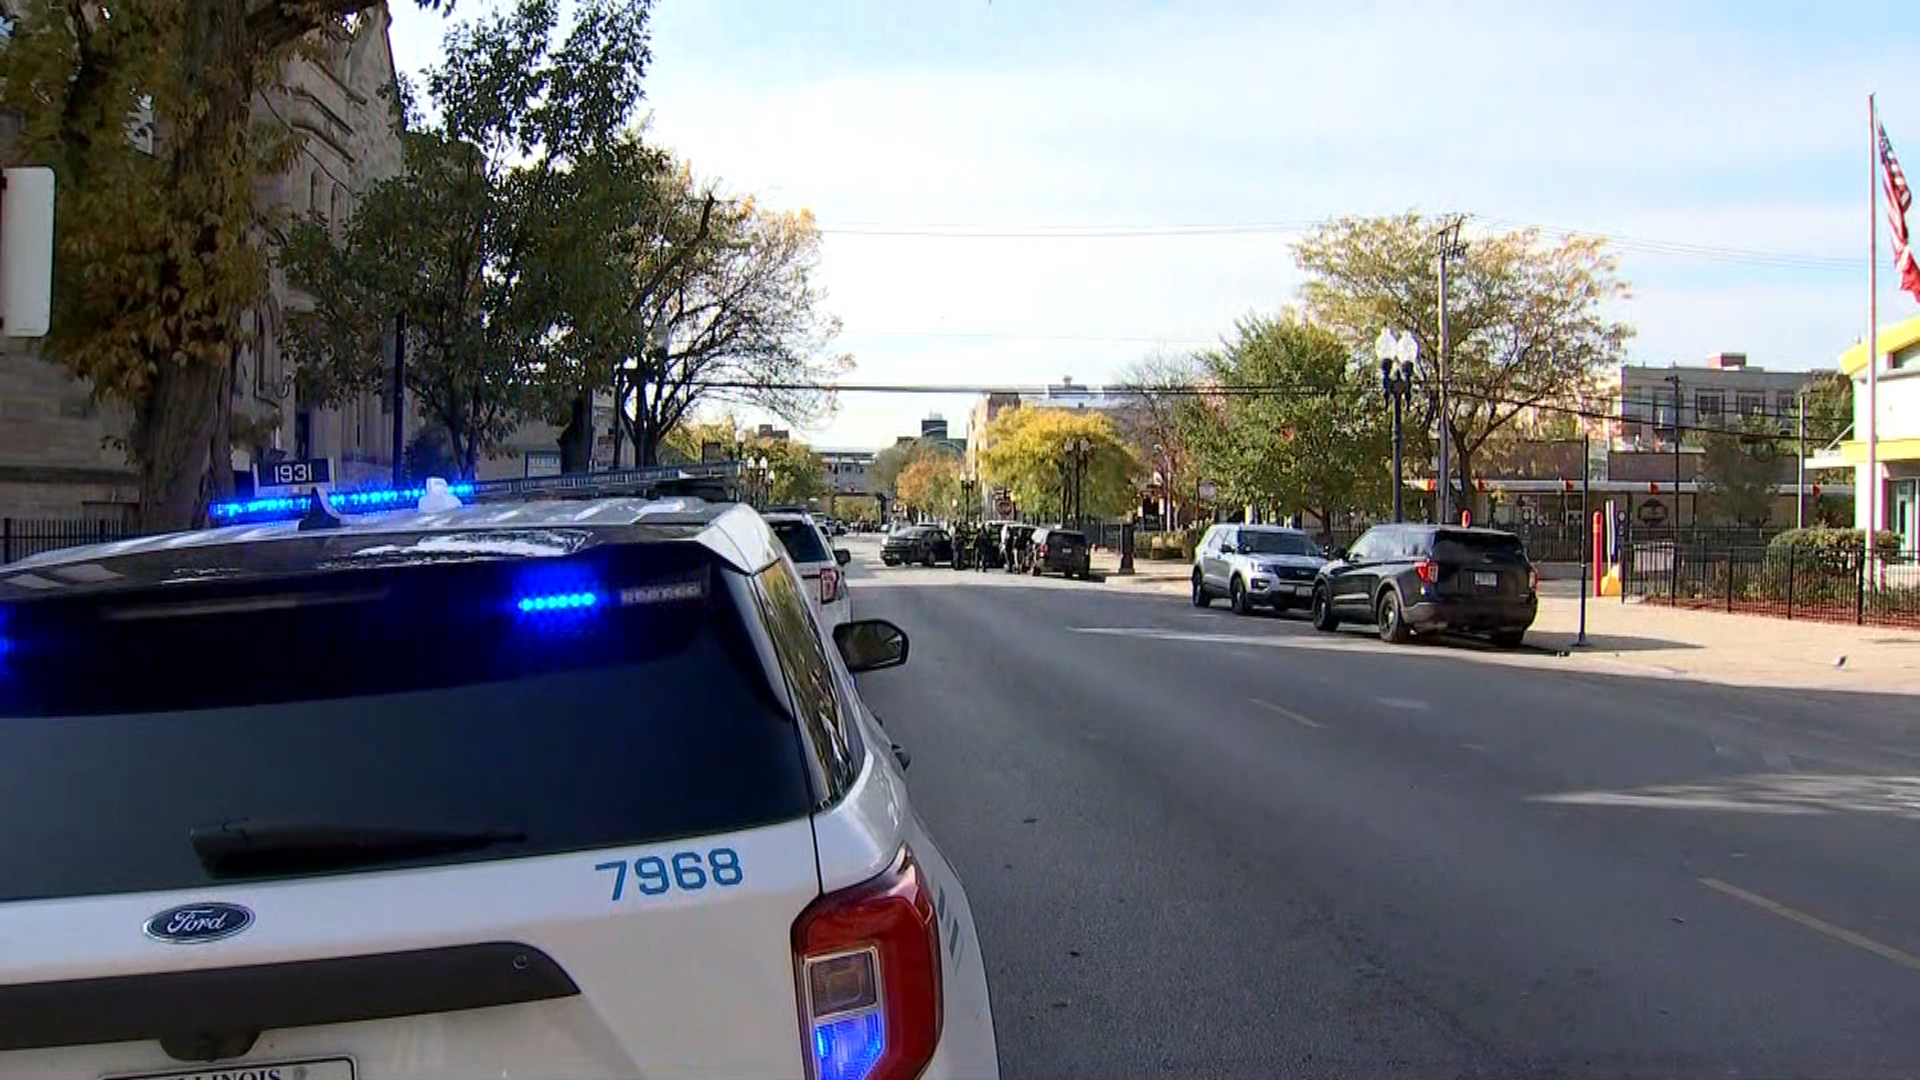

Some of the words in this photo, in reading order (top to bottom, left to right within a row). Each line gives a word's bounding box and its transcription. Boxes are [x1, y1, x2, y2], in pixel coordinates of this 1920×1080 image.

[274, 463, 312, 483] 1931
[595, 848, 743, 901] 7968
[166, 908, 229, 933] Ford
